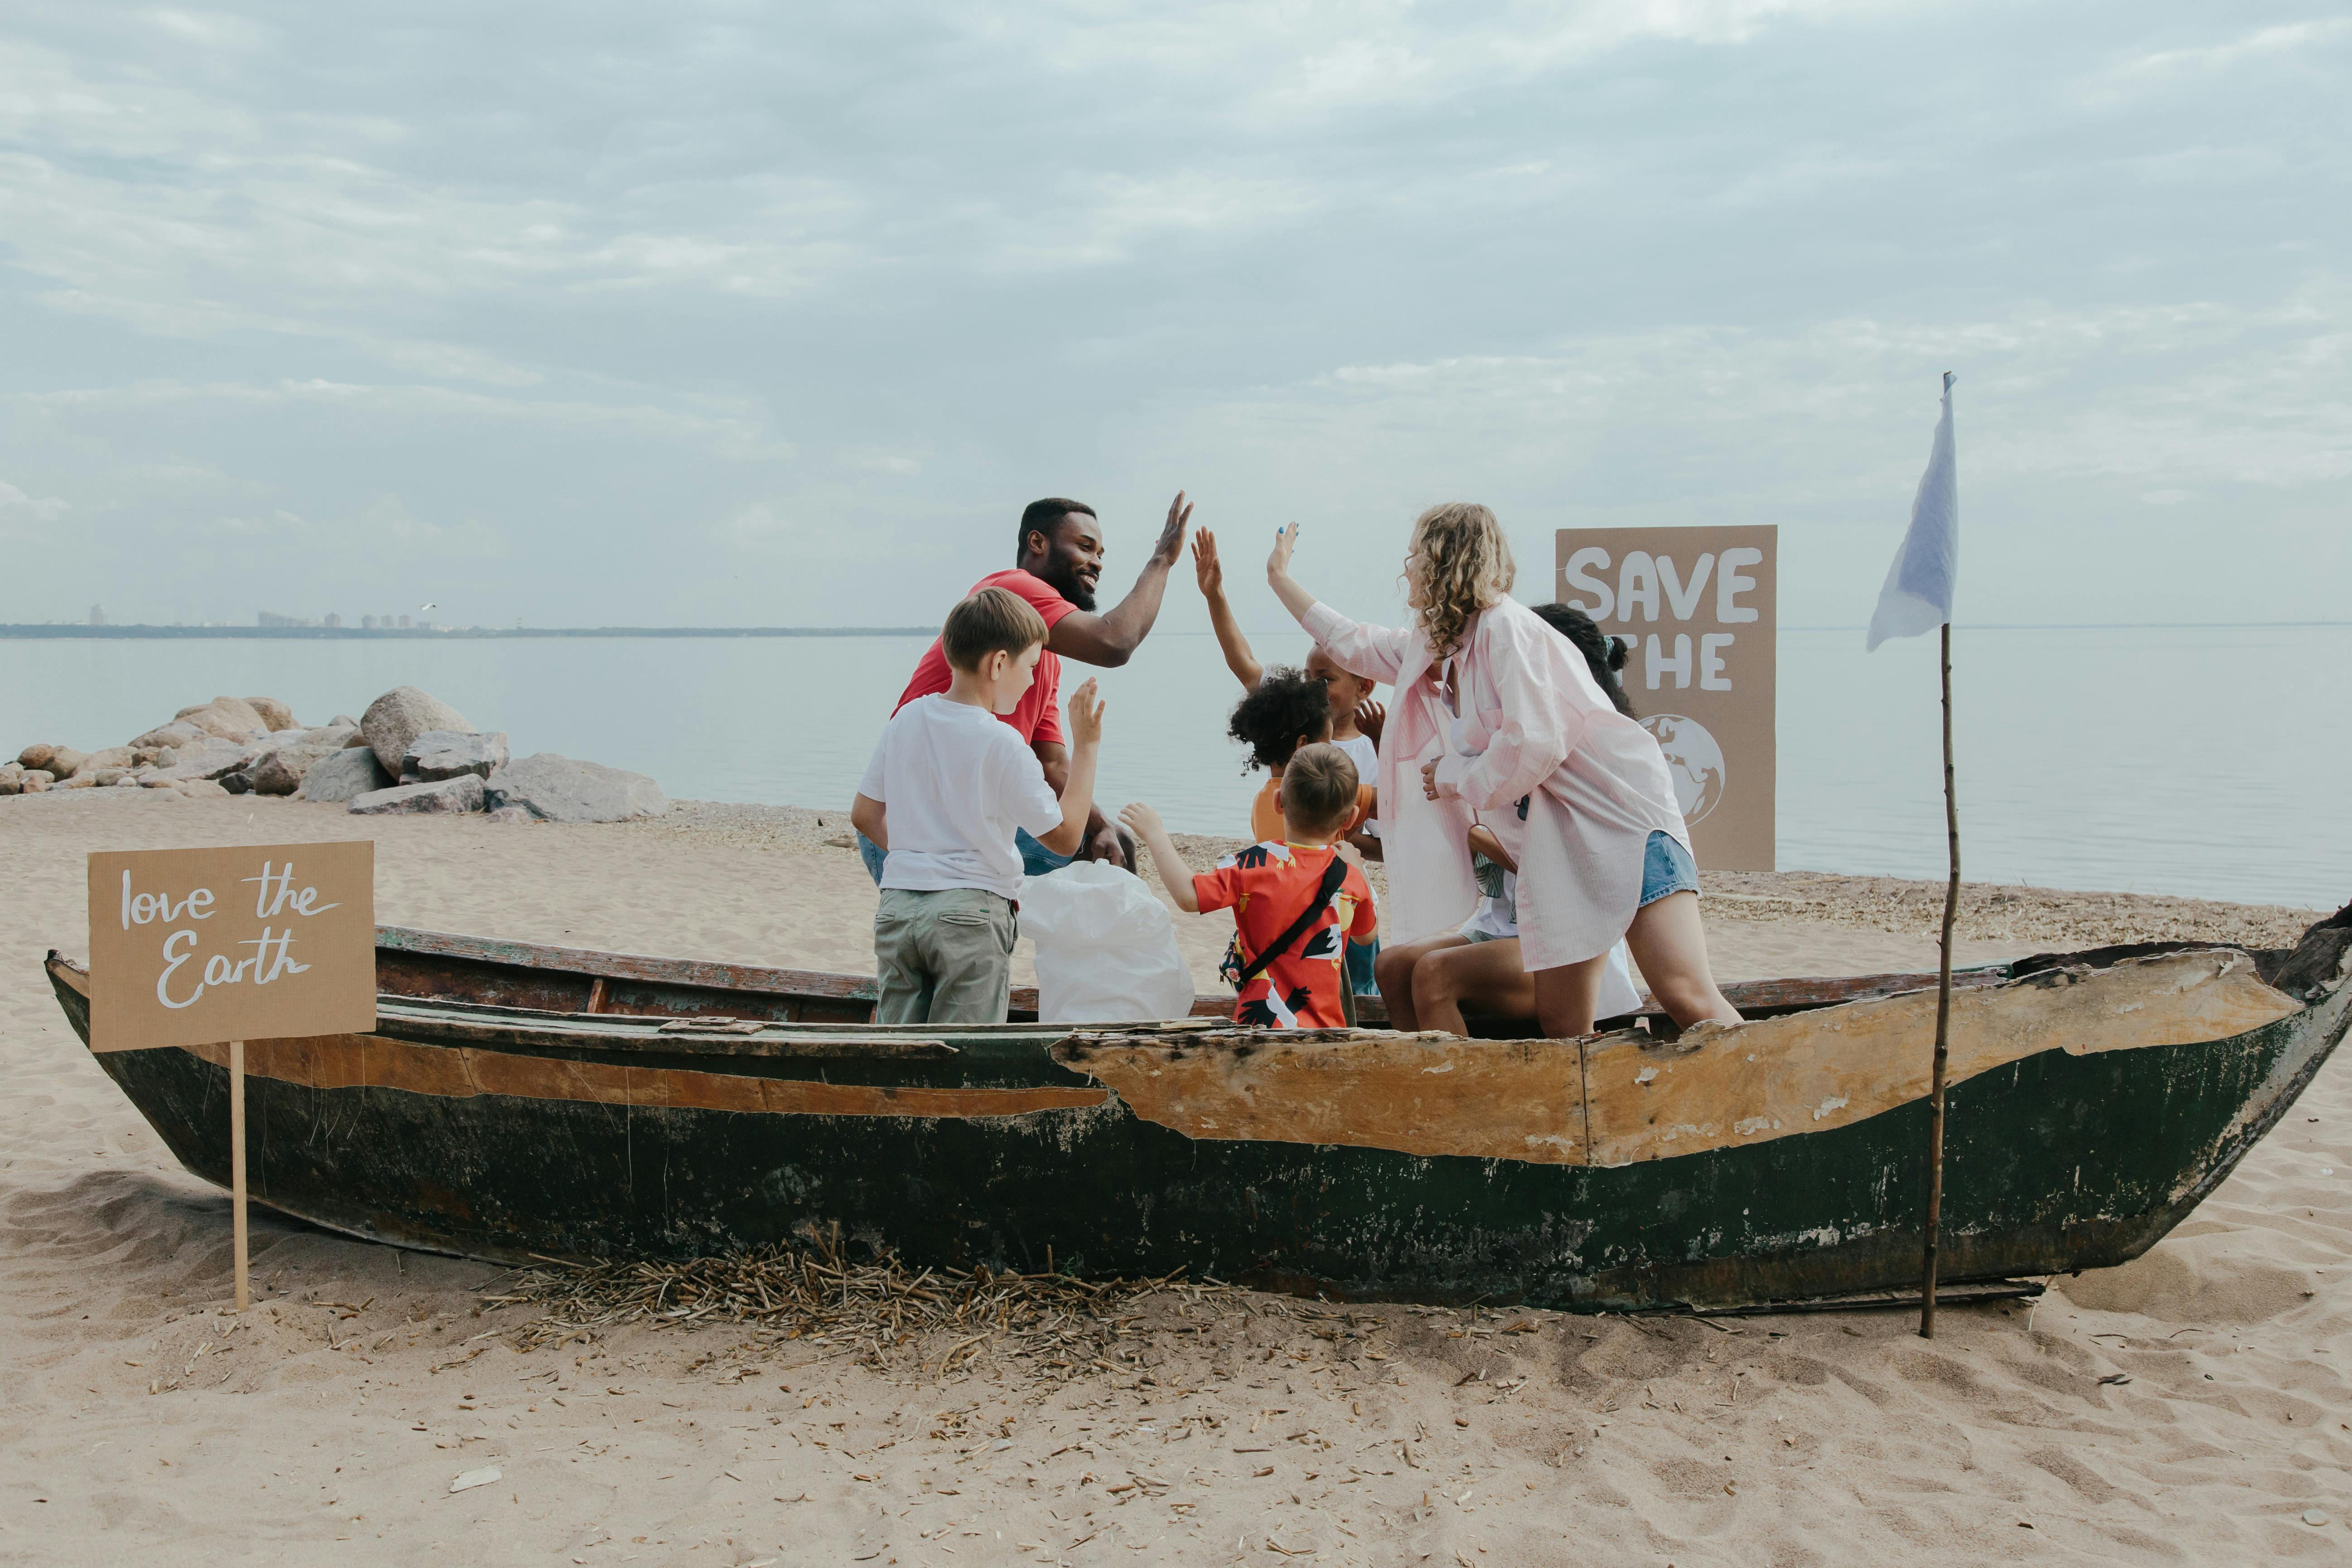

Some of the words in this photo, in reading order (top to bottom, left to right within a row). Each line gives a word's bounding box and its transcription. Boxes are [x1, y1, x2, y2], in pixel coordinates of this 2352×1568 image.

[1565, 547, 1763, 623] SAVE
[1604, 633, 1735, 691] HE
[122, 869, 216, 930] love
[240, 861, 343, 918] the
[157, 926, 312, 1009] Earth
